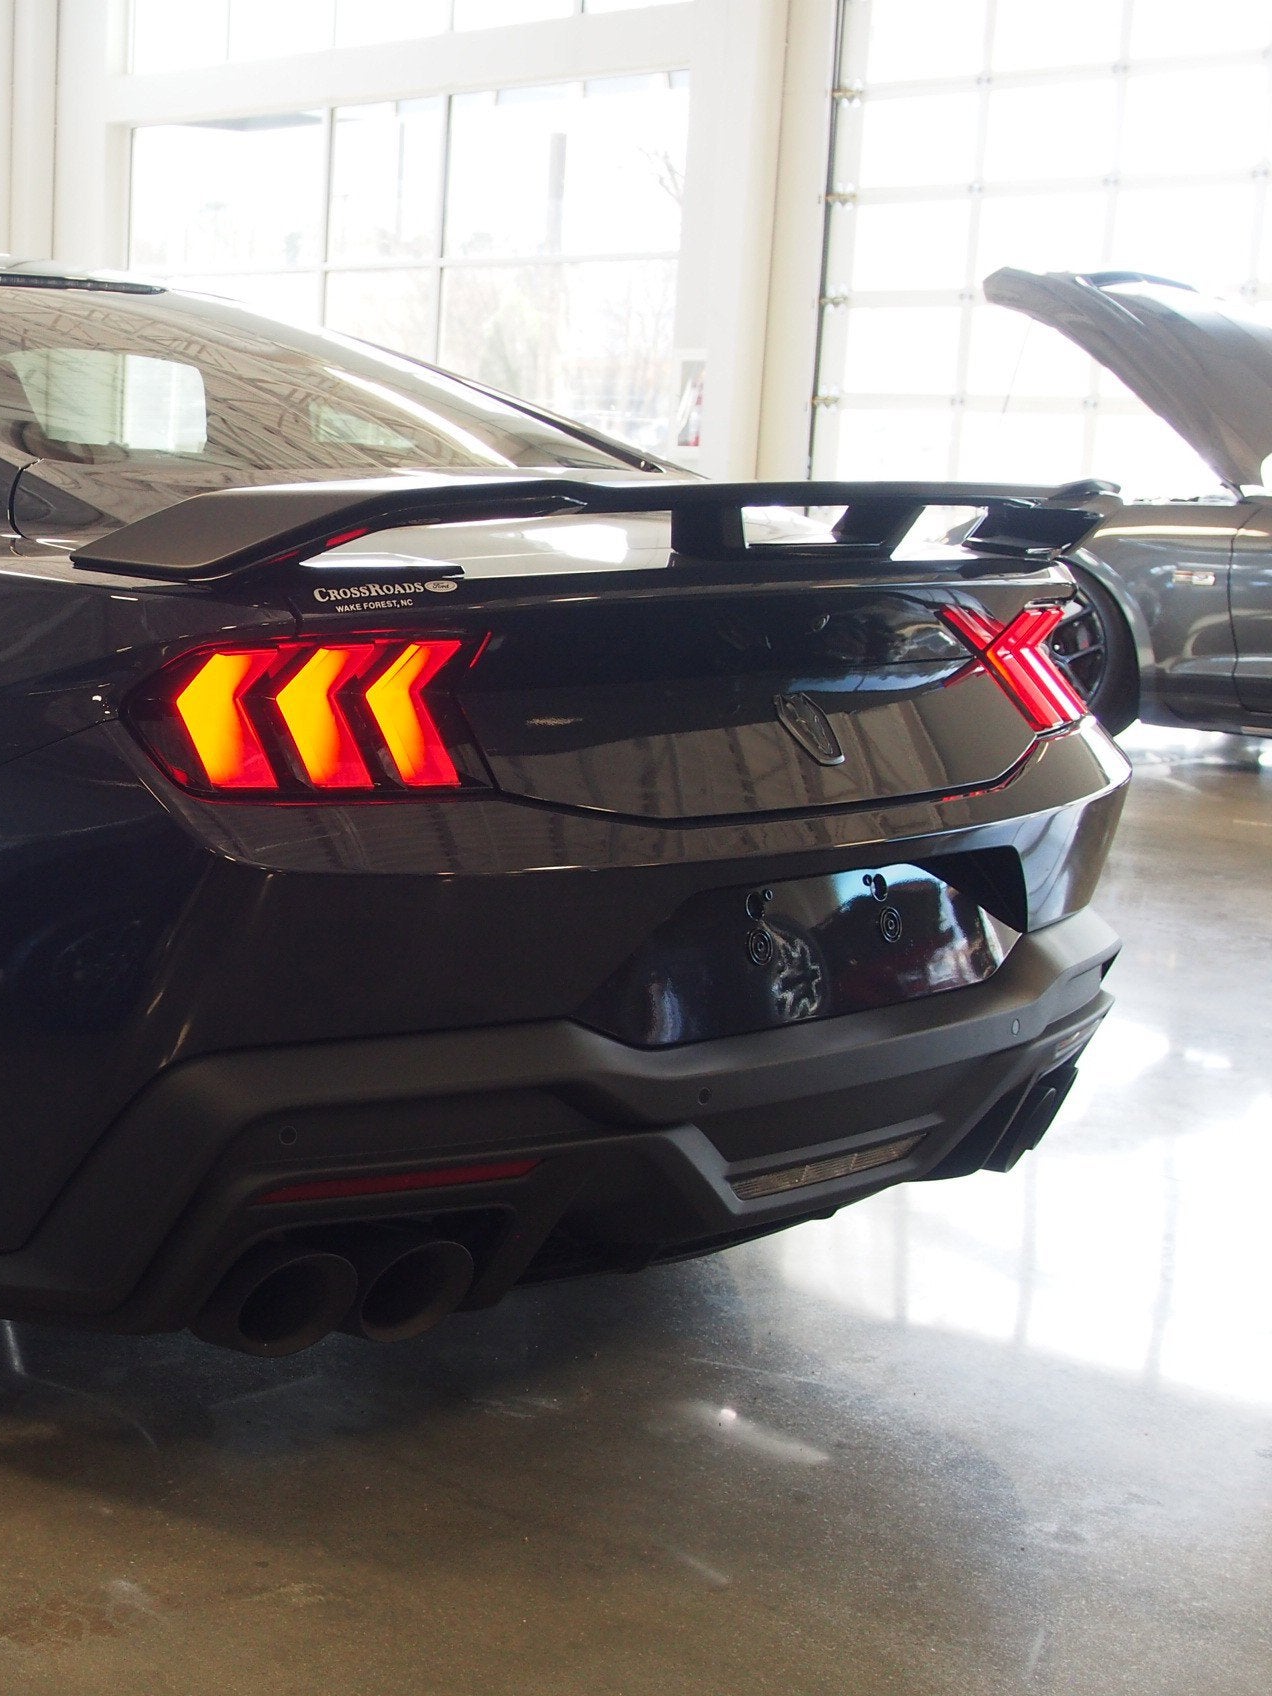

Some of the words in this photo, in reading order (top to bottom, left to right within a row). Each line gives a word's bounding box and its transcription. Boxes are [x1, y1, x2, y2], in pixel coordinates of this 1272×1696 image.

[335, 604, 362, 613] WAKE
[363, 600, 400, 609] FOREST,
[401, 598, 414, 606] NC
